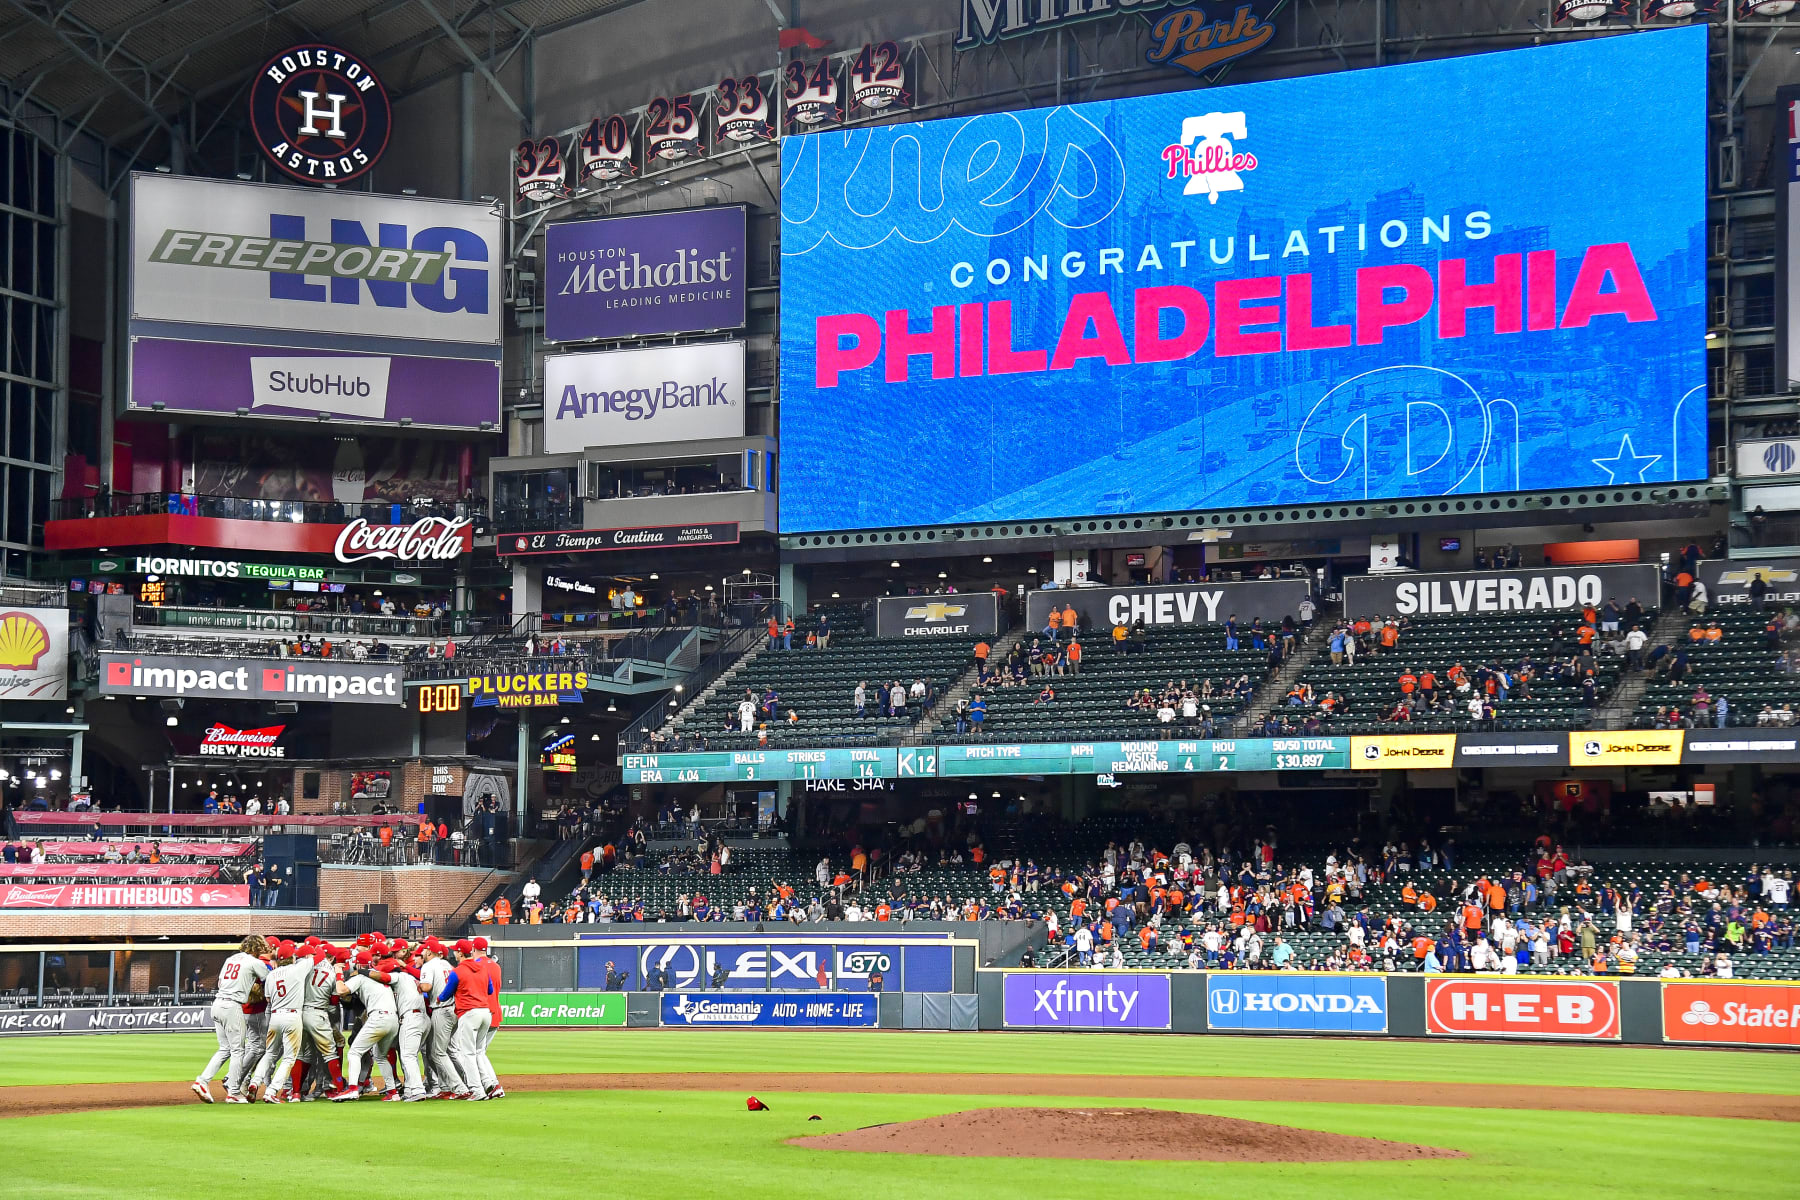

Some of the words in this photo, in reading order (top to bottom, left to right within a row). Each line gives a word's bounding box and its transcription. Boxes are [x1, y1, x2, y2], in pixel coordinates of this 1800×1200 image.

[1146, 6, 1270, 70] Park
[851, 41, 900, 83] 42
[267, 49, 375, 93] HOUSTON
[784, 56, 833, 100] 34
[716, 76, 762, 117] 33
[298, 90, 347, 139] H
[646, 94, 694, 137] 25
[726, 120, 755, 131] SCOTT
[581, 114, 627, 156] 40
[272, 142, 368, 178] ASTROS
[517, 138, 560, 178] 32
[1162, 143, 1258, 179] Phillies
[159, 232, 441, 281] FREEPORT
[558, 247, 627, 263] HOUSTON
[950, 210, 1494, 289] CONGRATULATIONS
[269, 213, 489, 315] LNG
[557, 248, 732, 296] Methodist
[606, 295, 661, 309] LEADING
[668, 289, 732, 303] MEDICINE
[816, 241, 1658, 389] PHILADELPHIA
[269, 370, 371, 398] StubHub
[555, 376, 730, 421] AmegyBank
[334, 515, 472, 563] Coca-Cola
[531, 534, 546, 549] El
[556, 533, 603, 550] Tiempo
[613, 530, 664, 545] Cantina
[677, 533, 713, 542] MARGARITAS
[136, 556, 238, 578] HORNITOS
[245, 565, 296, 578] TEQUILA
[298, 568, 324, 579] BAR
[1395, 574, 1603, 616] SILVERADO
[1108, 590, 1225, 625] CHEVY
[904, 624, 969, 637] CHEVROLET
[133, 659, 249, 693] impact
[286, 665, 396, 699] impact
[467, 671, 589, 694] PLUCKERS
[419, 685, 460, 712] 0:00
[498, 694, 532, 707] WING
[534, 692, 559, 706] BAR
[205, 727, 277, 744] Budweiser
[200, 743, 238, 756] BREW
[241, 744, 285, 758] HOUSE
[966, 747, 994, 758] PITCH
[995, 746, 1021, 757] TYPE
[1071, 745, 1094, 756] MPH
[1121, 742, 1159, 753] MOUND
[1178, 742, 1197, 753] PHI
[1212, 741, 1235, 752] HOU
[1272, 740, 1300, 751] 50/50
[1301, 739, 1336, 750] TOTAL
[1383, 747, 1410, 757] JOHN
[1412, 746, 1445, 757] DEERE
[1605, 743, 1635, 754] JOHN
[1636, 743, 1672, 753] DEERE
[626, 756, 658, 768] EFLIN
[734, 753, 765, 763] BALLS
[787, 752, 826, 763] STRIKES
[851, 750, 880, 761] TOTAL
[898, 753, 914, 775] K
[917, 754, 937, 773] 12
[1126, 752, 1157, 762] VISITS
[1184, 757, 1194, 770] 4
[1219, 756, 1228, 770] 2
[433, 766, 448, 774] THIS
[746, 766, 754, 780] 3
[802, 764, 815, 778] 11
[859, 763, 874, 777] 14
[1111, 761, 1169, 772] REMAINING
[432, 775, 454, 784] BUD'S
[640, 770, 663, 782] ERA
[677, 769, 699, 782] 4.04
[432, 784, 446, 792] FOR
[852, 779, 885, 791] SHA
[71, 886, 193, 905] #HITTHEBUDS
[224, 963, 241, 980] 28
[851, 955, 892, 972] 370
[311, 968, 330, 988] 17
[275, 979, 287, 998] 5
[700, 998, 761, 1014] Germania
[1033, 979, 1139, 1022] xfinity
[1243, 992, 1383, 1015] HONDA
[1450, 991, 1596, 1024] H-E-B
[530, 1004, 556, 1018] Car
[557, 1004, 606, 1018] Rental
[772, 1003, 797, 1018] AUTO
[805, 1003, 834, 1018] HOME
[842, 1002, 863, 1018] LIFE
[88, 1010, 205, 1028] NITTOTIRE.COM
